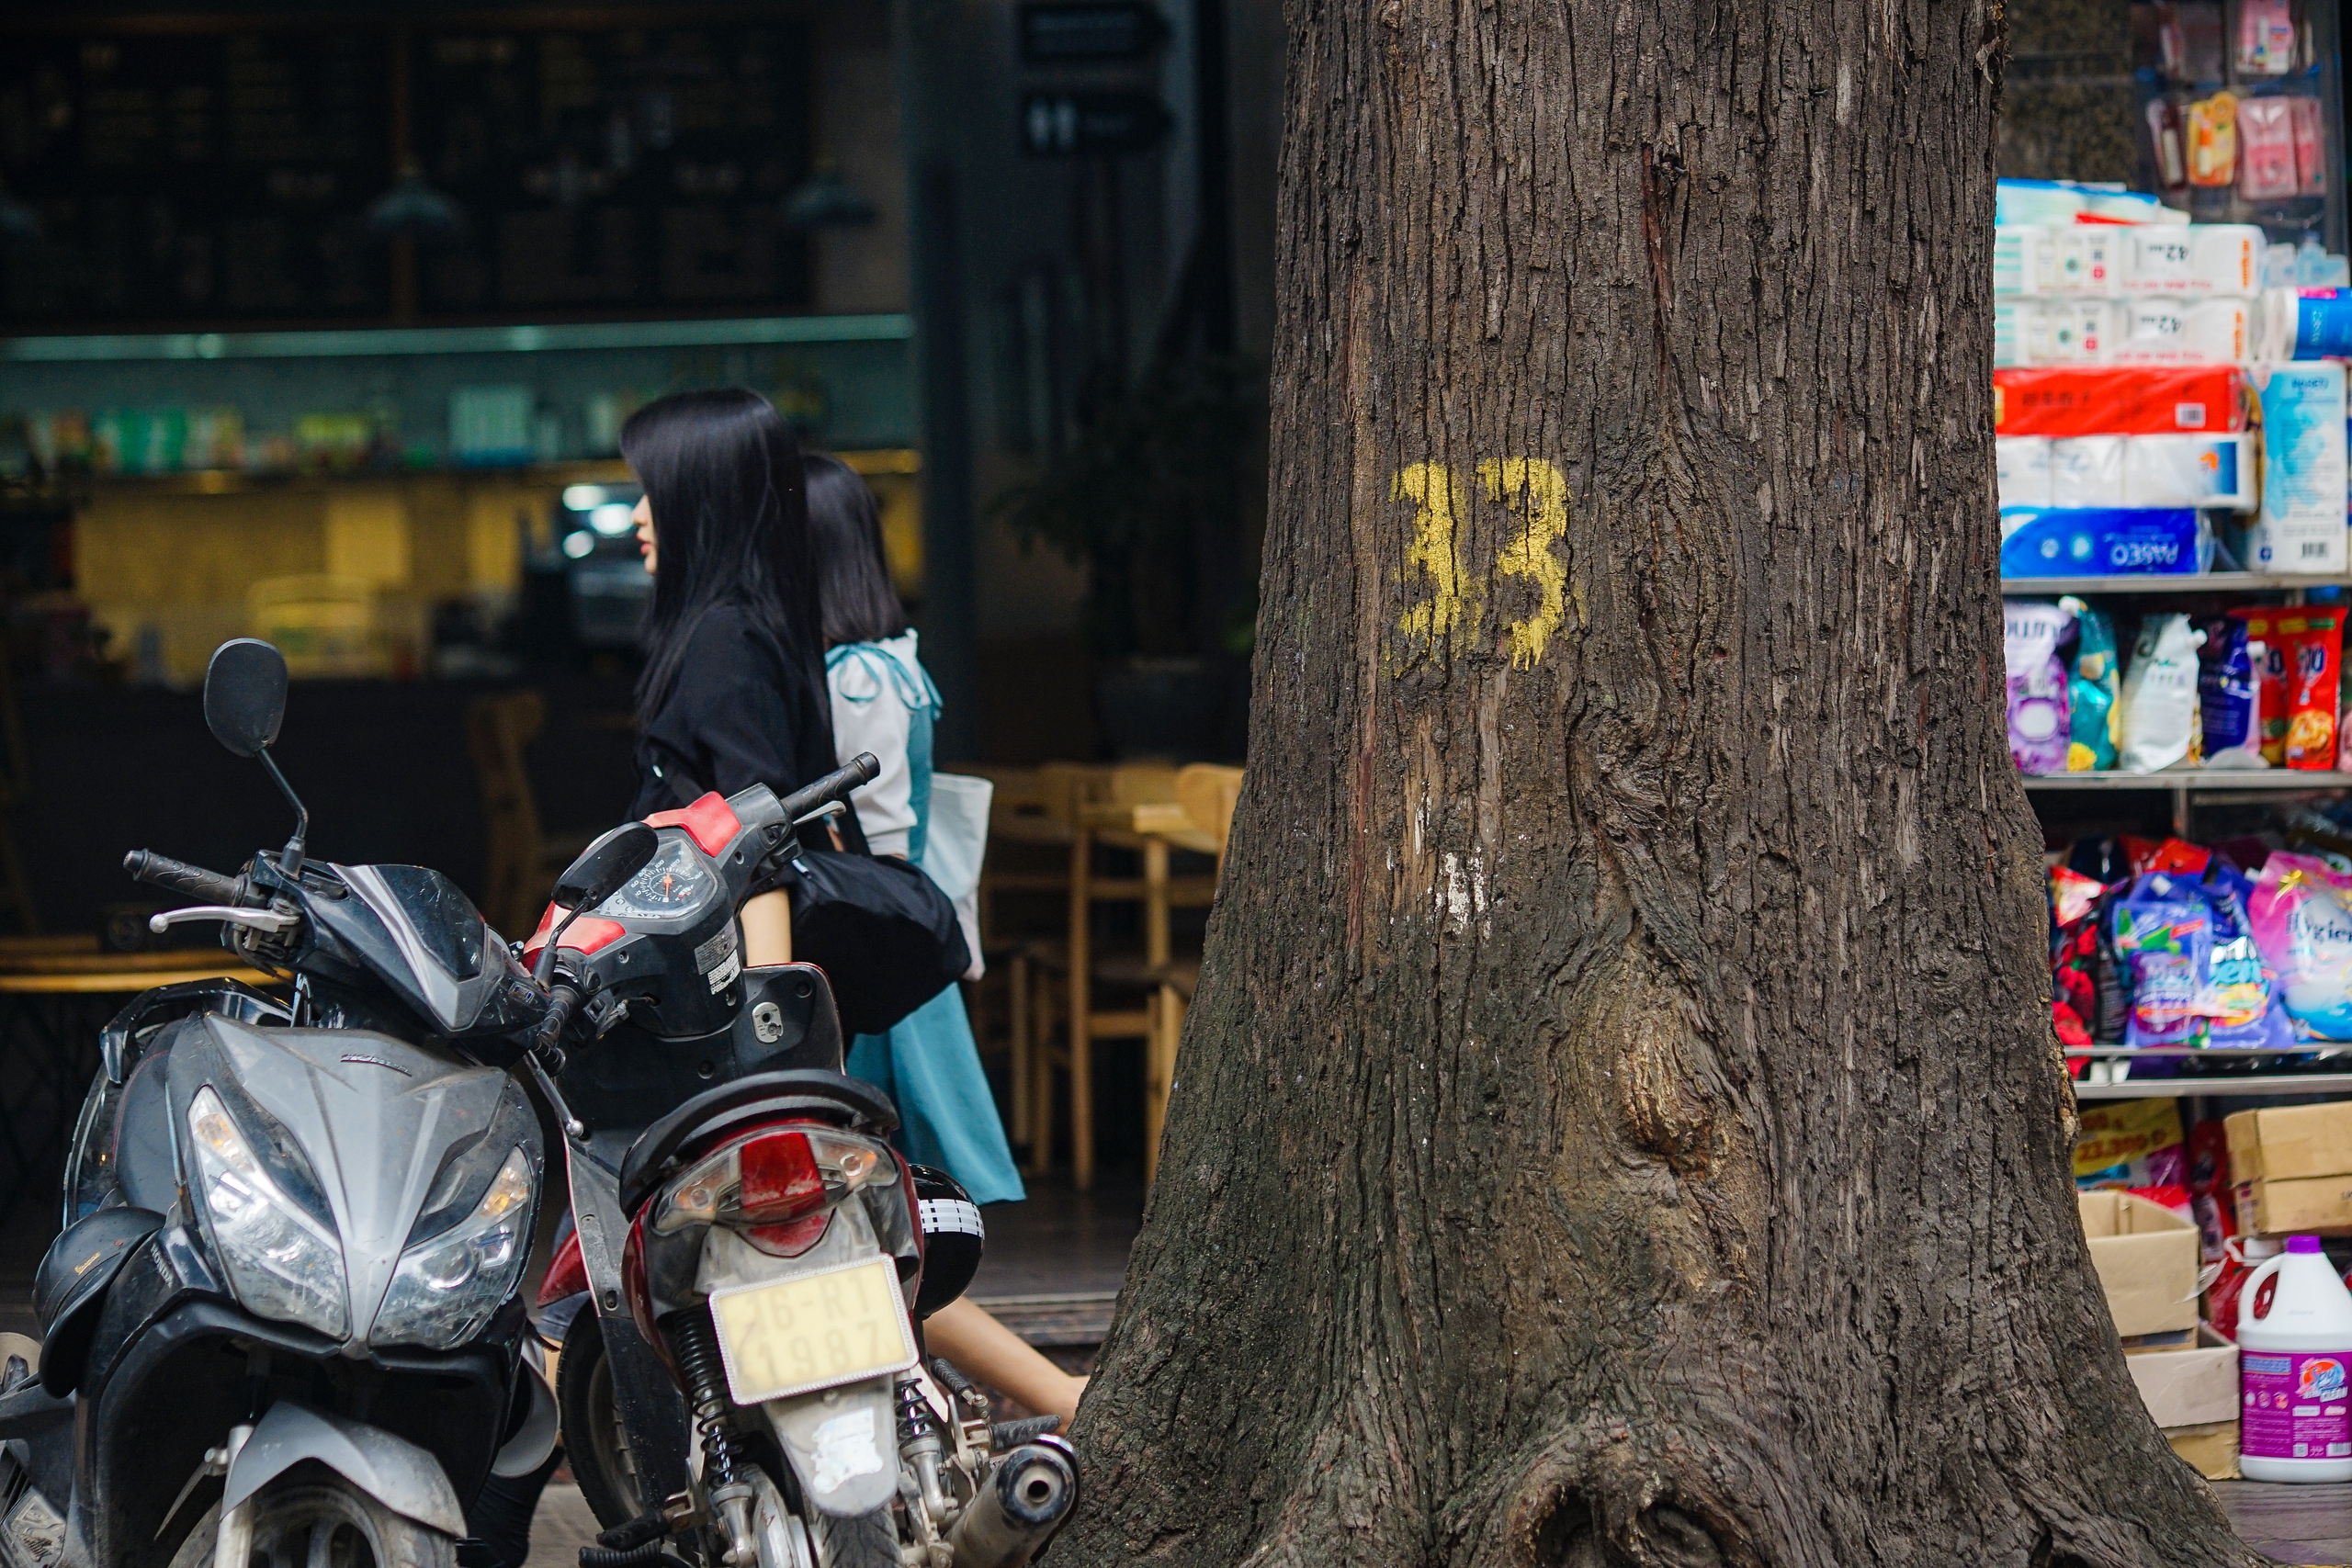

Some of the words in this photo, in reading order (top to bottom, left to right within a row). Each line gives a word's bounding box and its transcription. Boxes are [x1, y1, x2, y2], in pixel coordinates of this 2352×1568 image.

[2110, 542, 2179, 567] PASEO
[150, 1242, 174, 1288] HONDA
[757, 1319, 880, 1387] 1987
